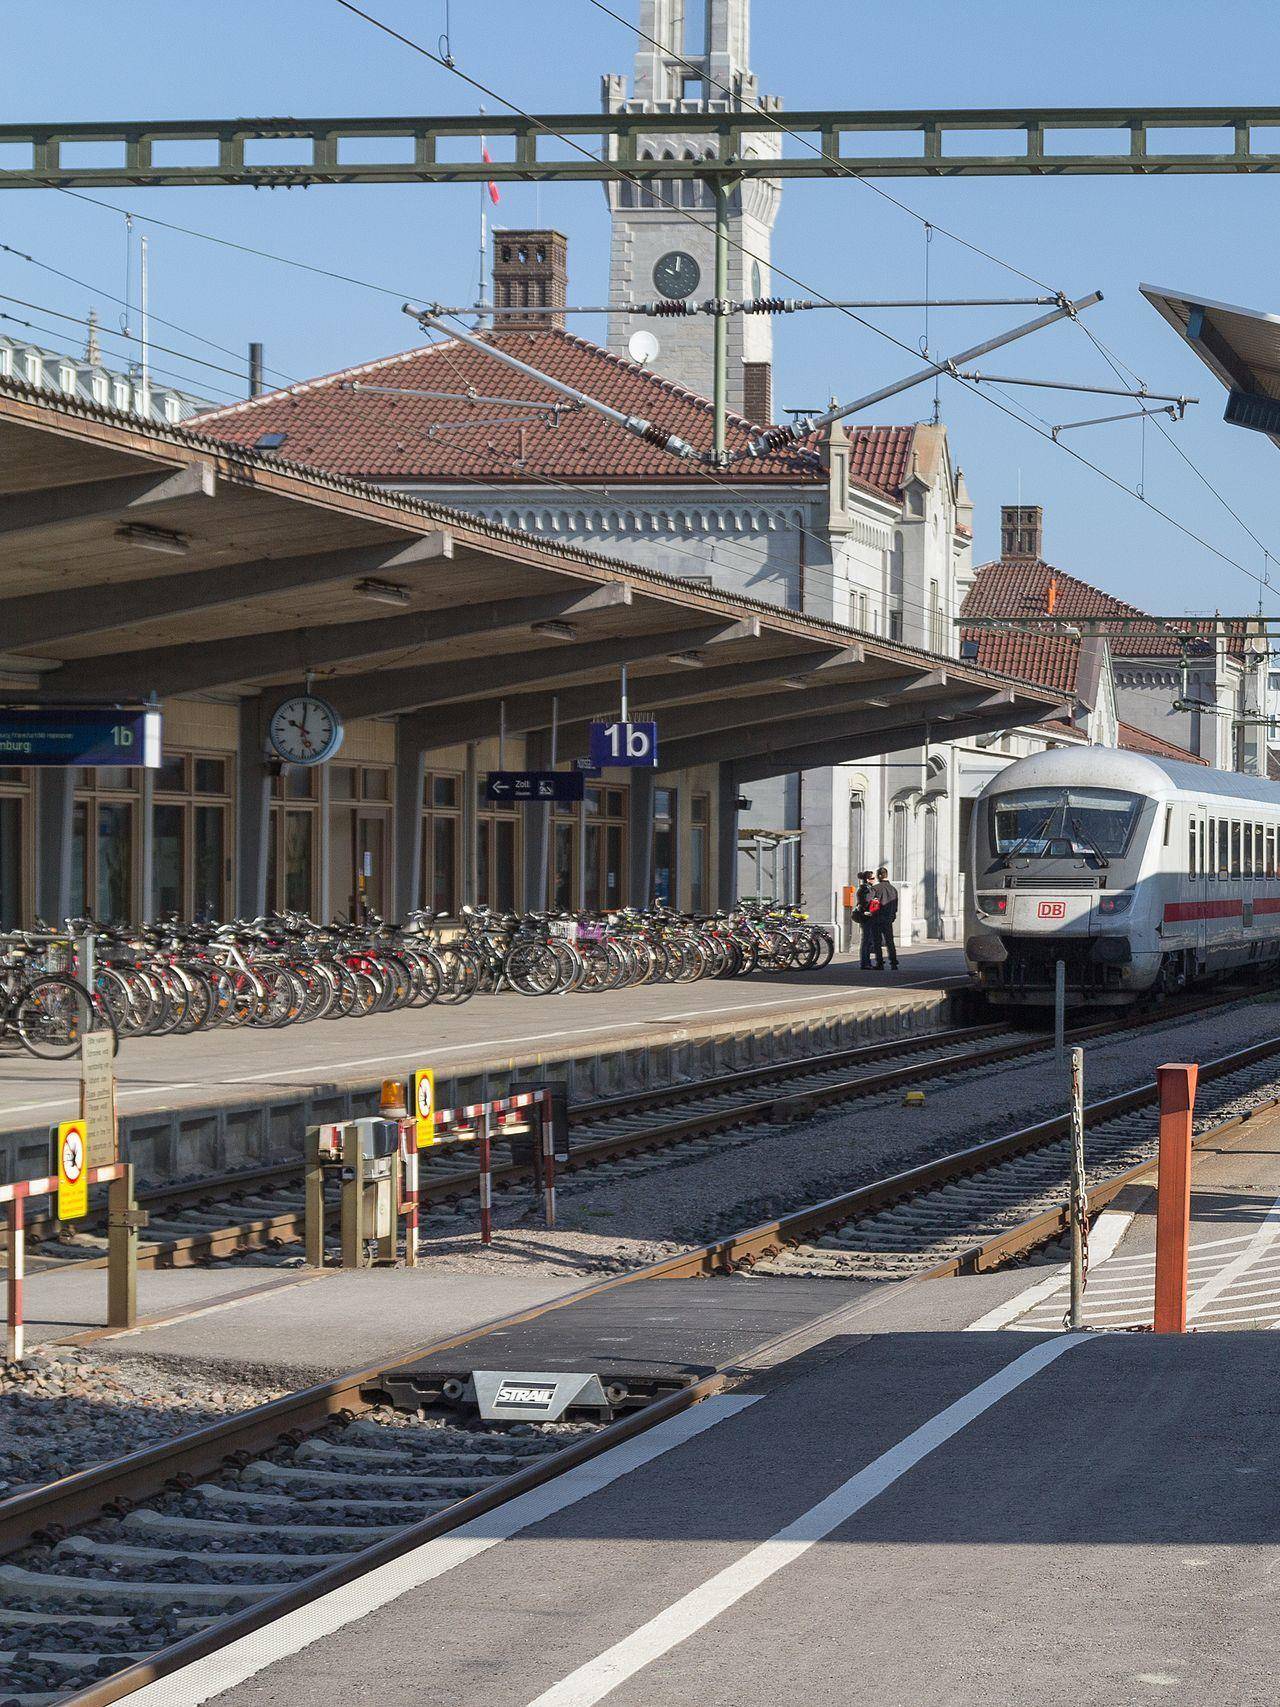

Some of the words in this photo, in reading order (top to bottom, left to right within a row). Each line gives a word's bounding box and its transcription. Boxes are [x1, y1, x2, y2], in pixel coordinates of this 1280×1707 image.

[110, 726, 134, 746] 1b
[603, 723, 650, 757] 1b
[1040, 903, 1063, 917] DB
[498, 1387, 553, 1402] STRAIL
